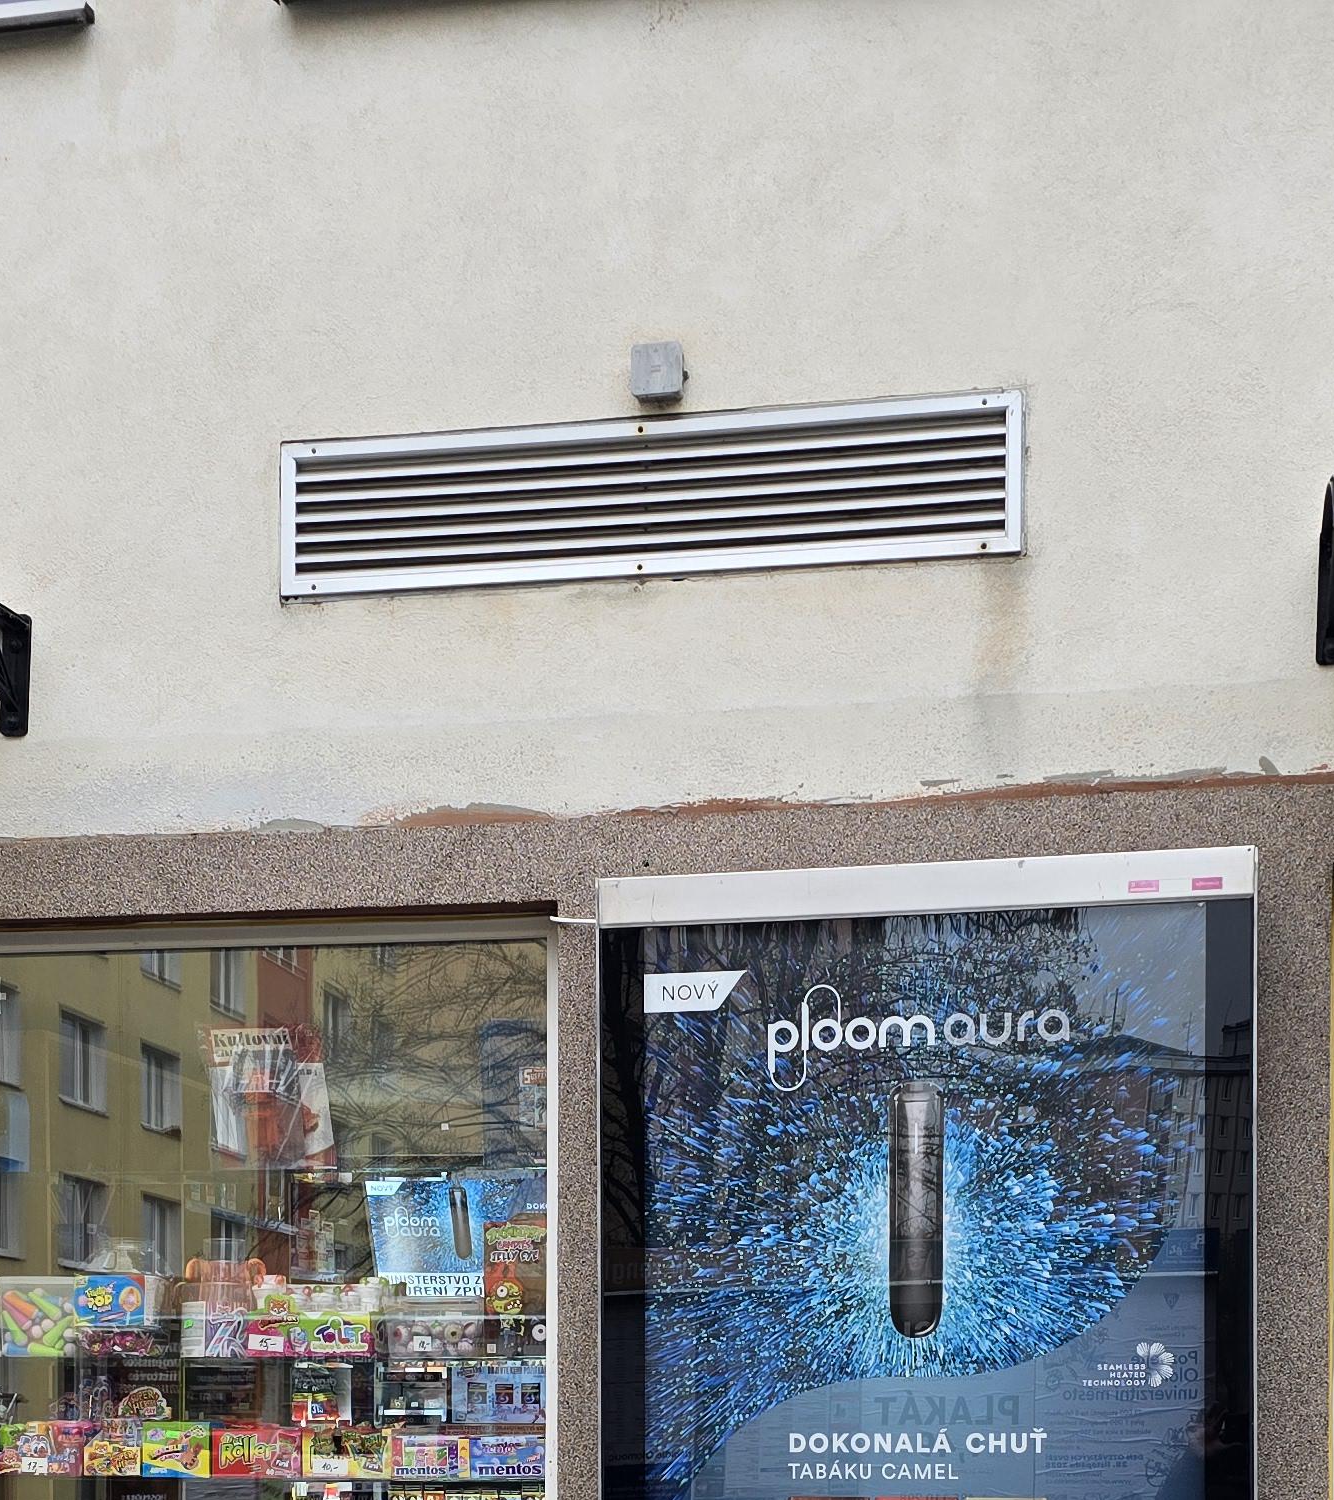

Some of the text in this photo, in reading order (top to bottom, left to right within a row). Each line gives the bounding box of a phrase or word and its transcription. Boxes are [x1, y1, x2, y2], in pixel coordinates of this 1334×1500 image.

[661, 980, 720, 1001] NOVÝ
[767, 983, 1070, 1092] ploom aura
[384, 1207, 439, 1238] ploom
[400, 1226, 441, 1238] aura
[490, 1250, 539, 1264] JELLY EYE
[1097, 1363, 1146, 1371] SEAMLESS
[1082, 1379, 1147, 1387] TECHNOLOGY
[788, 1427, 1048, 1454] DOKONALÁ CHUŤ
[219, 1434, 277, 1469] Roller
[395, 1465, 447, 1476] mentos
[477, 1464, 543, 1476] mentos
[787, 1459, 959, 1480] TABÁKU CAMEL
